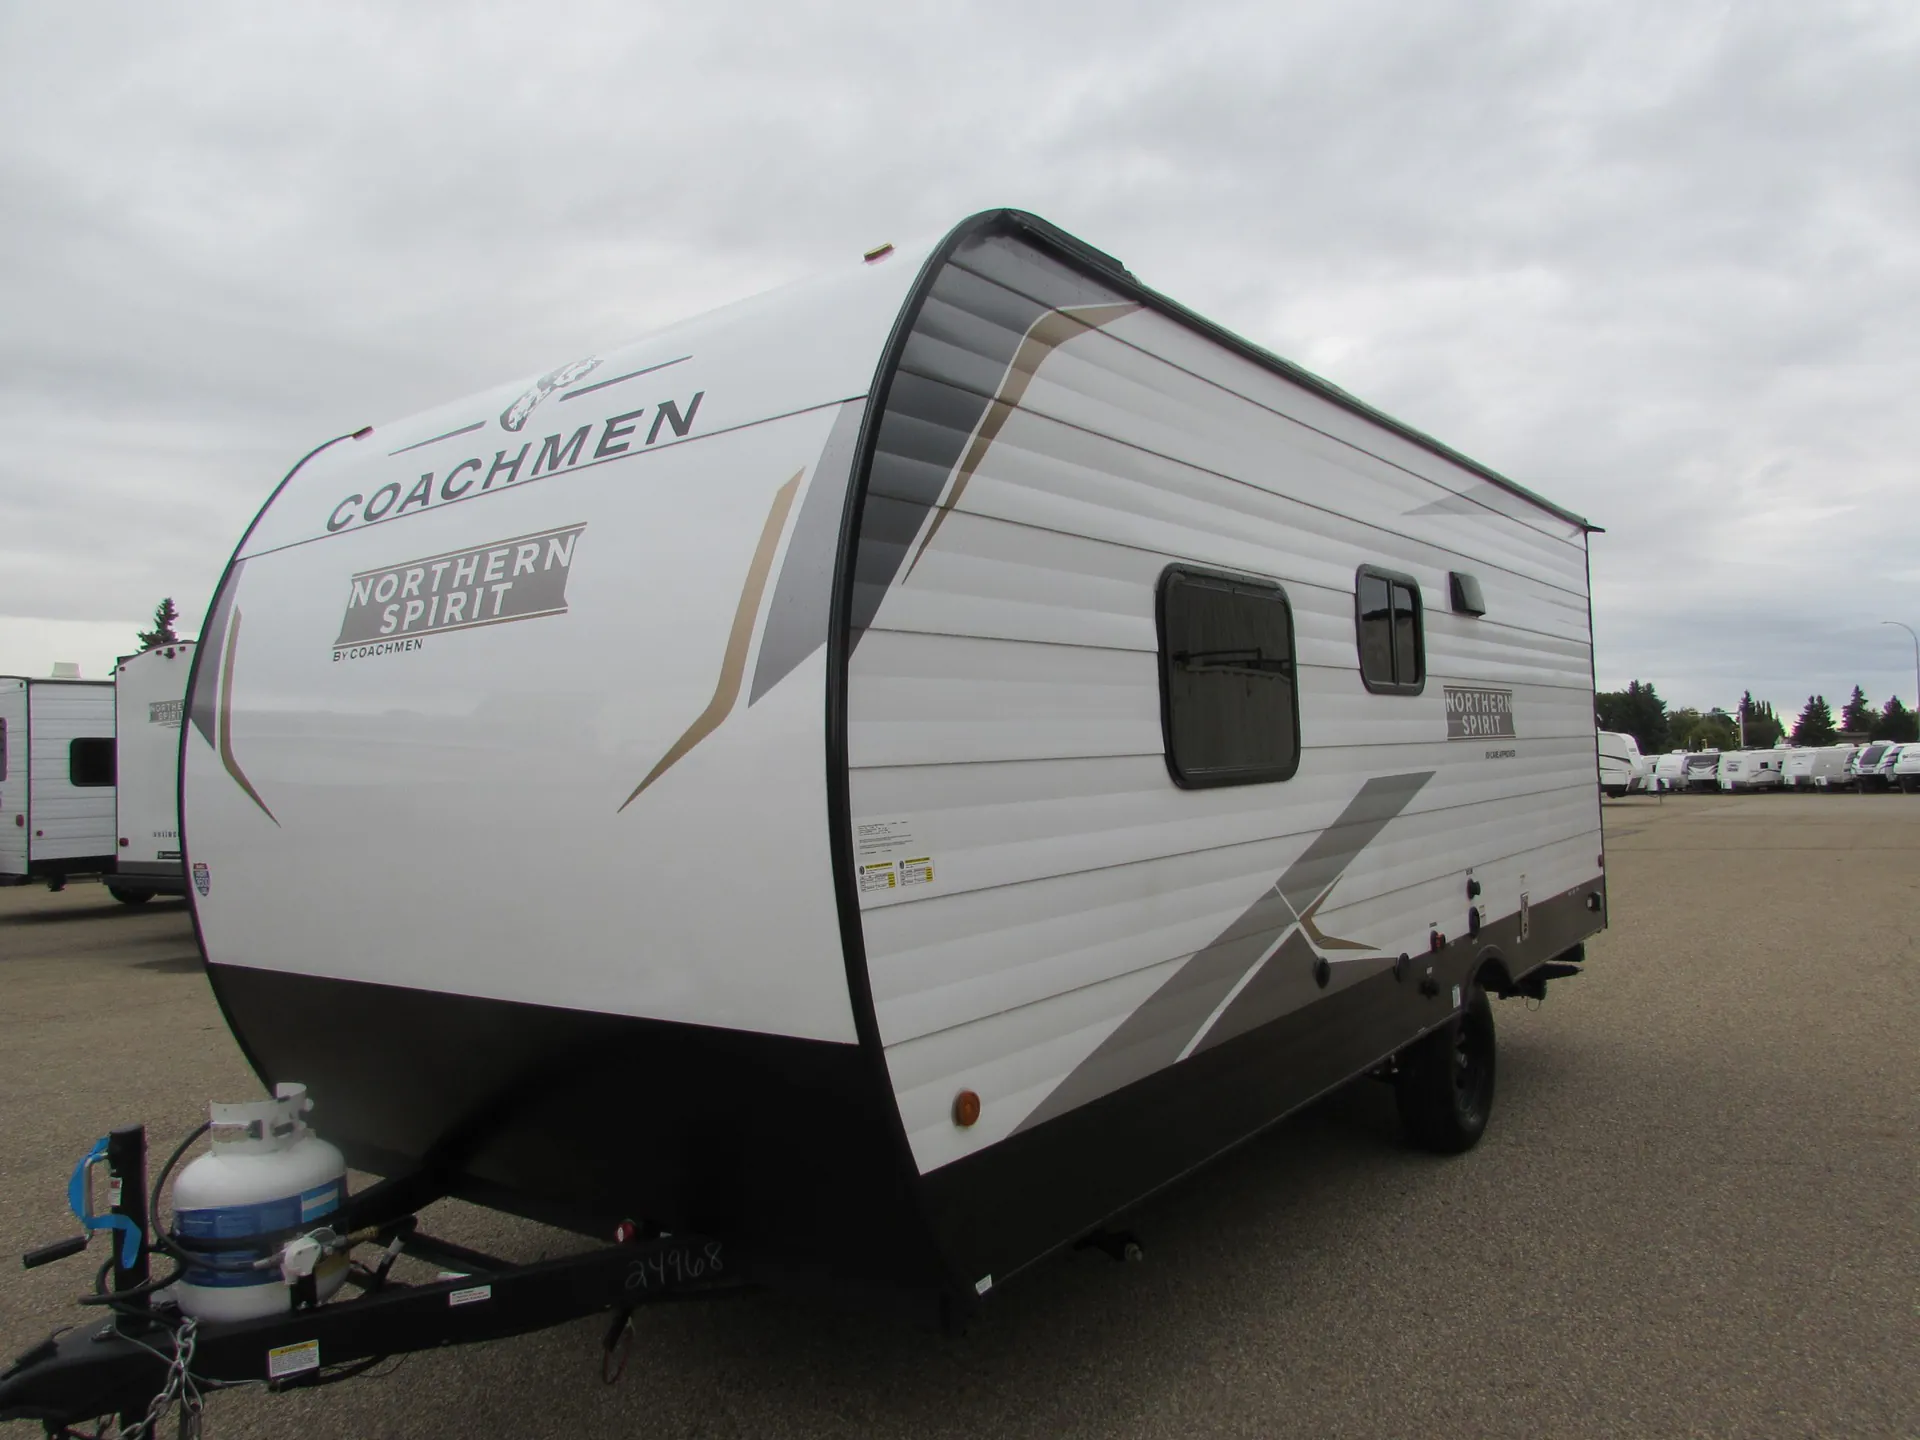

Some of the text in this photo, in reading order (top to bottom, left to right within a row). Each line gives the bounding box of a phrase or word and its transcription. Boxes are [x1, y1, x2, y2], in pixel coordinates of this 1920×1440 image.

[327, 391, 706, 533] COACHMEN
[349, 534, 577, 609] NORTHERN
[379, 581, 513, 635] SPIRIT
[333, 638, 424, 662] BY COACHMEN
[1445, 692, 1512, 713] NORTHERN
[1462, 714, 1501, 735] SPIRIT
[624, 1241, 723, 1290] 24968
